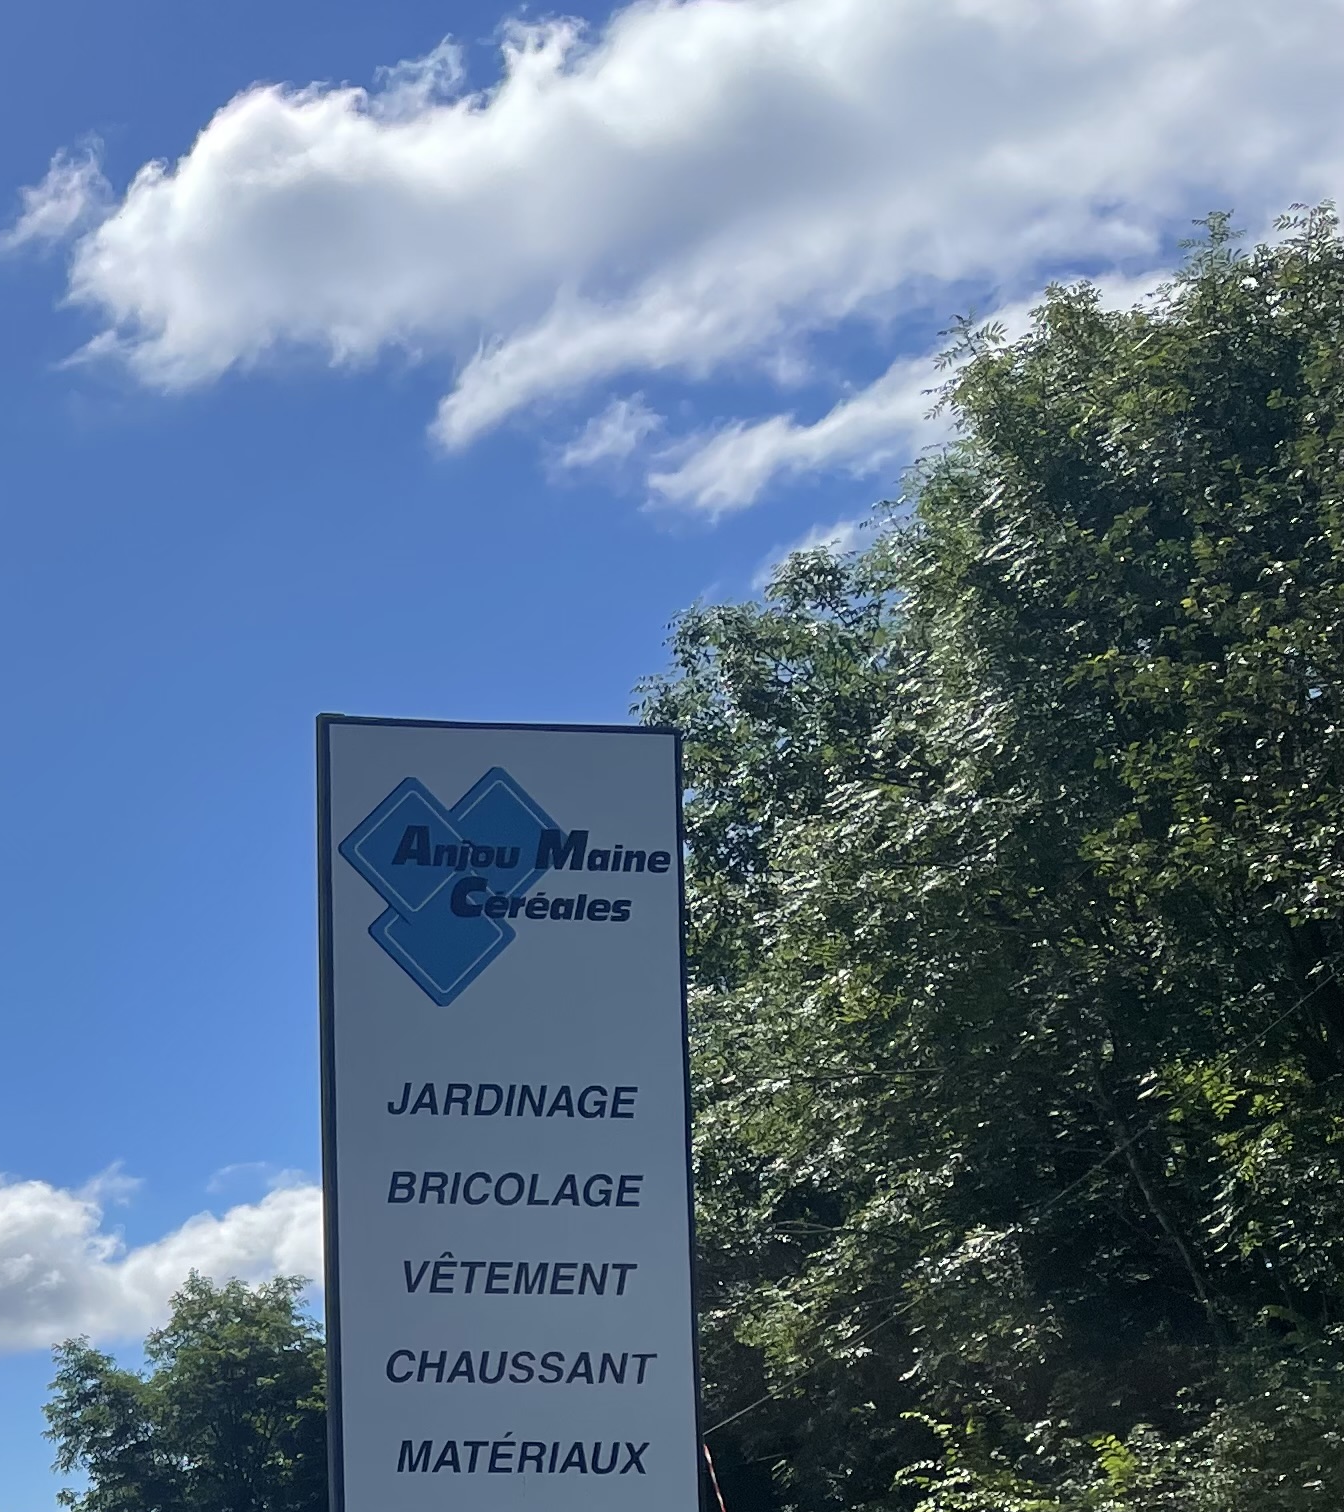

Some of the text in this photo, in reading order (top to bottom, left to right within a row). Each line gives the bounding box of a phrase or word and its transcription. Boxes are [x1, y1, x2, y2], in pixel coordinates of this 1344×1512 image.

[391, 824, 672, 874] Anjou Maine
[450, 876, 633, 922] Céréales
[387, 1082, 639, 1119] JARDINAGE
[386, 1171, 644, 1208] BRICOLAGE
[403, 1251, 638, 1296] VÊTEMENT
[385, 1349, 658, 1385] CHAUSSANT
[396, 1431, 651, 1475] MATÉRIAUX
